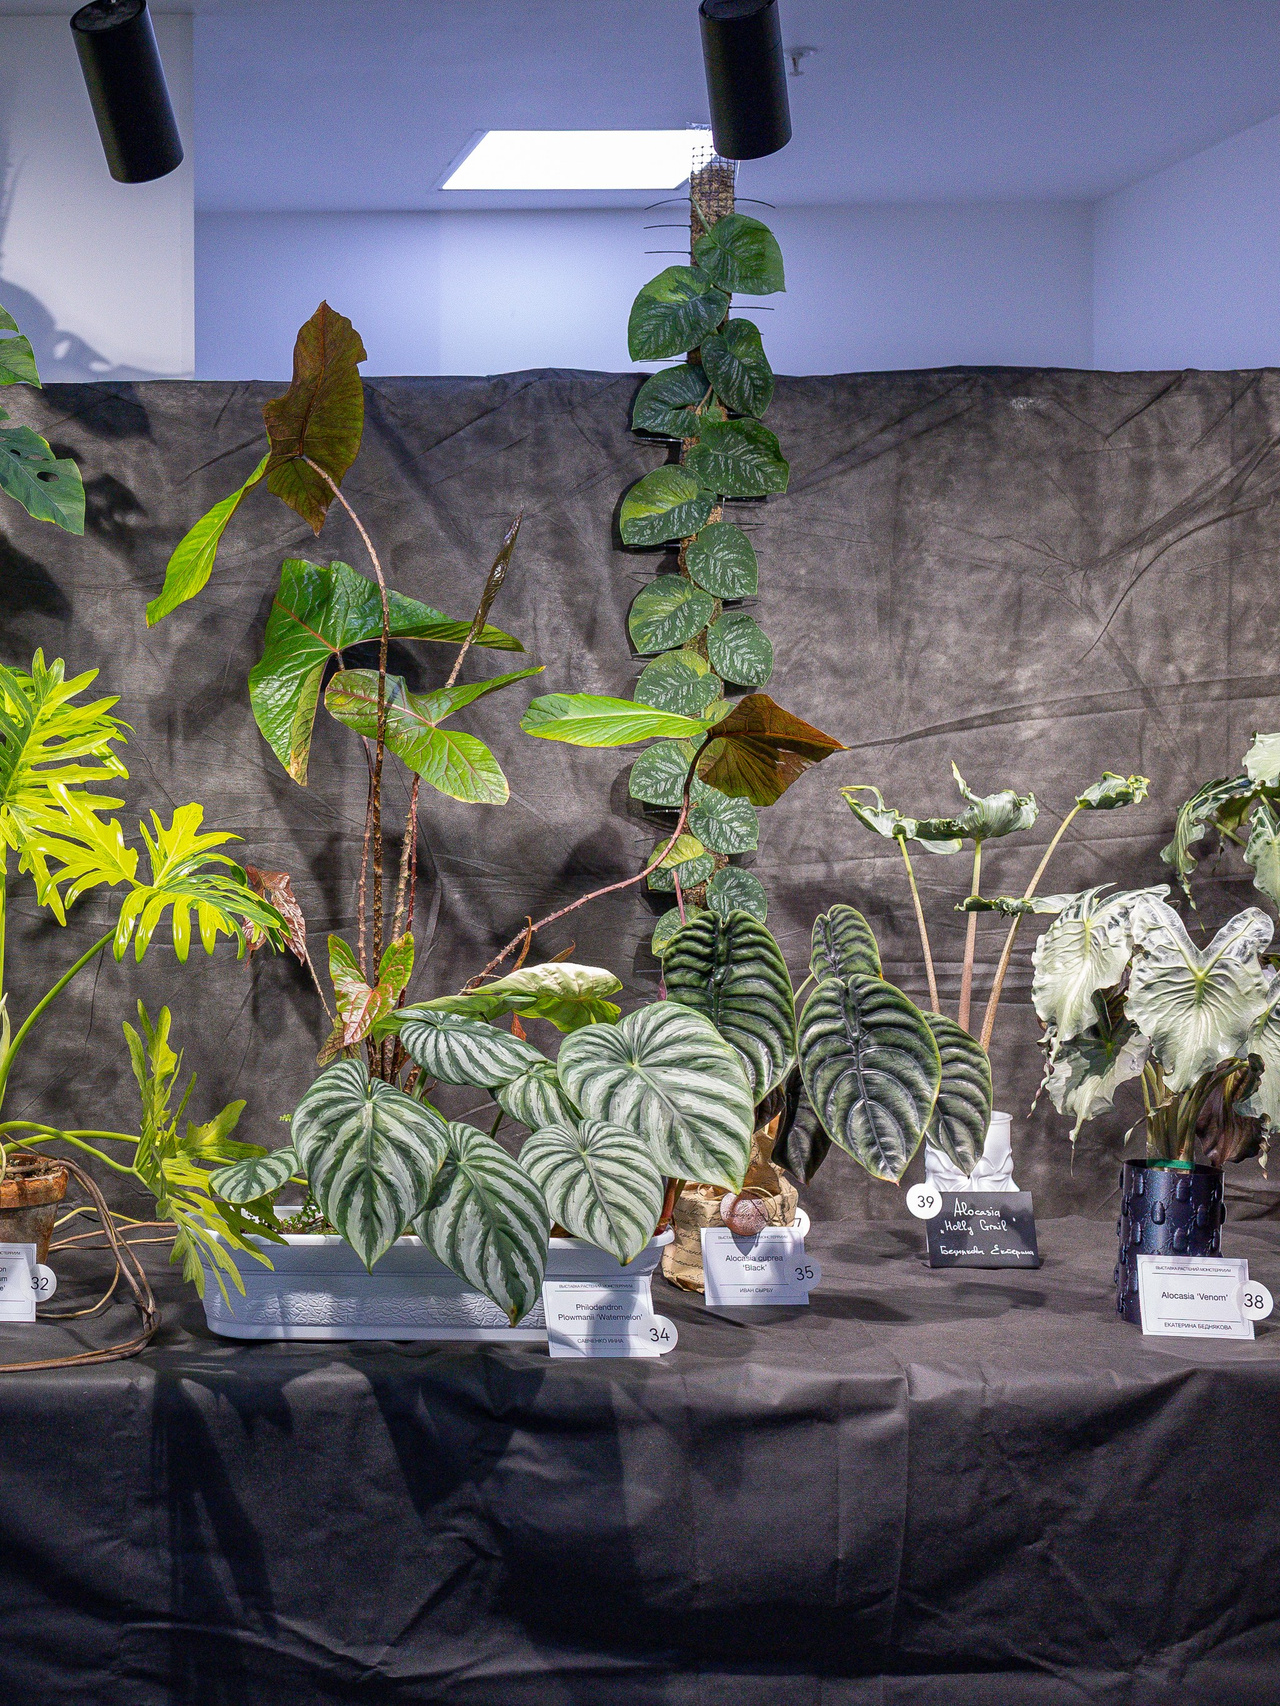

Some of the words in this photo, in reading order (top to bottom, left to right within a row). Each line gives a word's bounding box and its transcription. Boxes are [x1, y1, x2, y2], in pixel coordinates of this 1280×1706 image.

[917, 1195, 934, 1208] 39
[954, 1198, 1000, 1218] Alocasia
[795, 1265, 814, 1281] 35
[30, 1277, 49, 1290] 32
[1161, 1292, 1194, 1300] Alocasia
[1244, 1293, 1264, 1309] 38
[649, 1327, 670, 1342] 34
